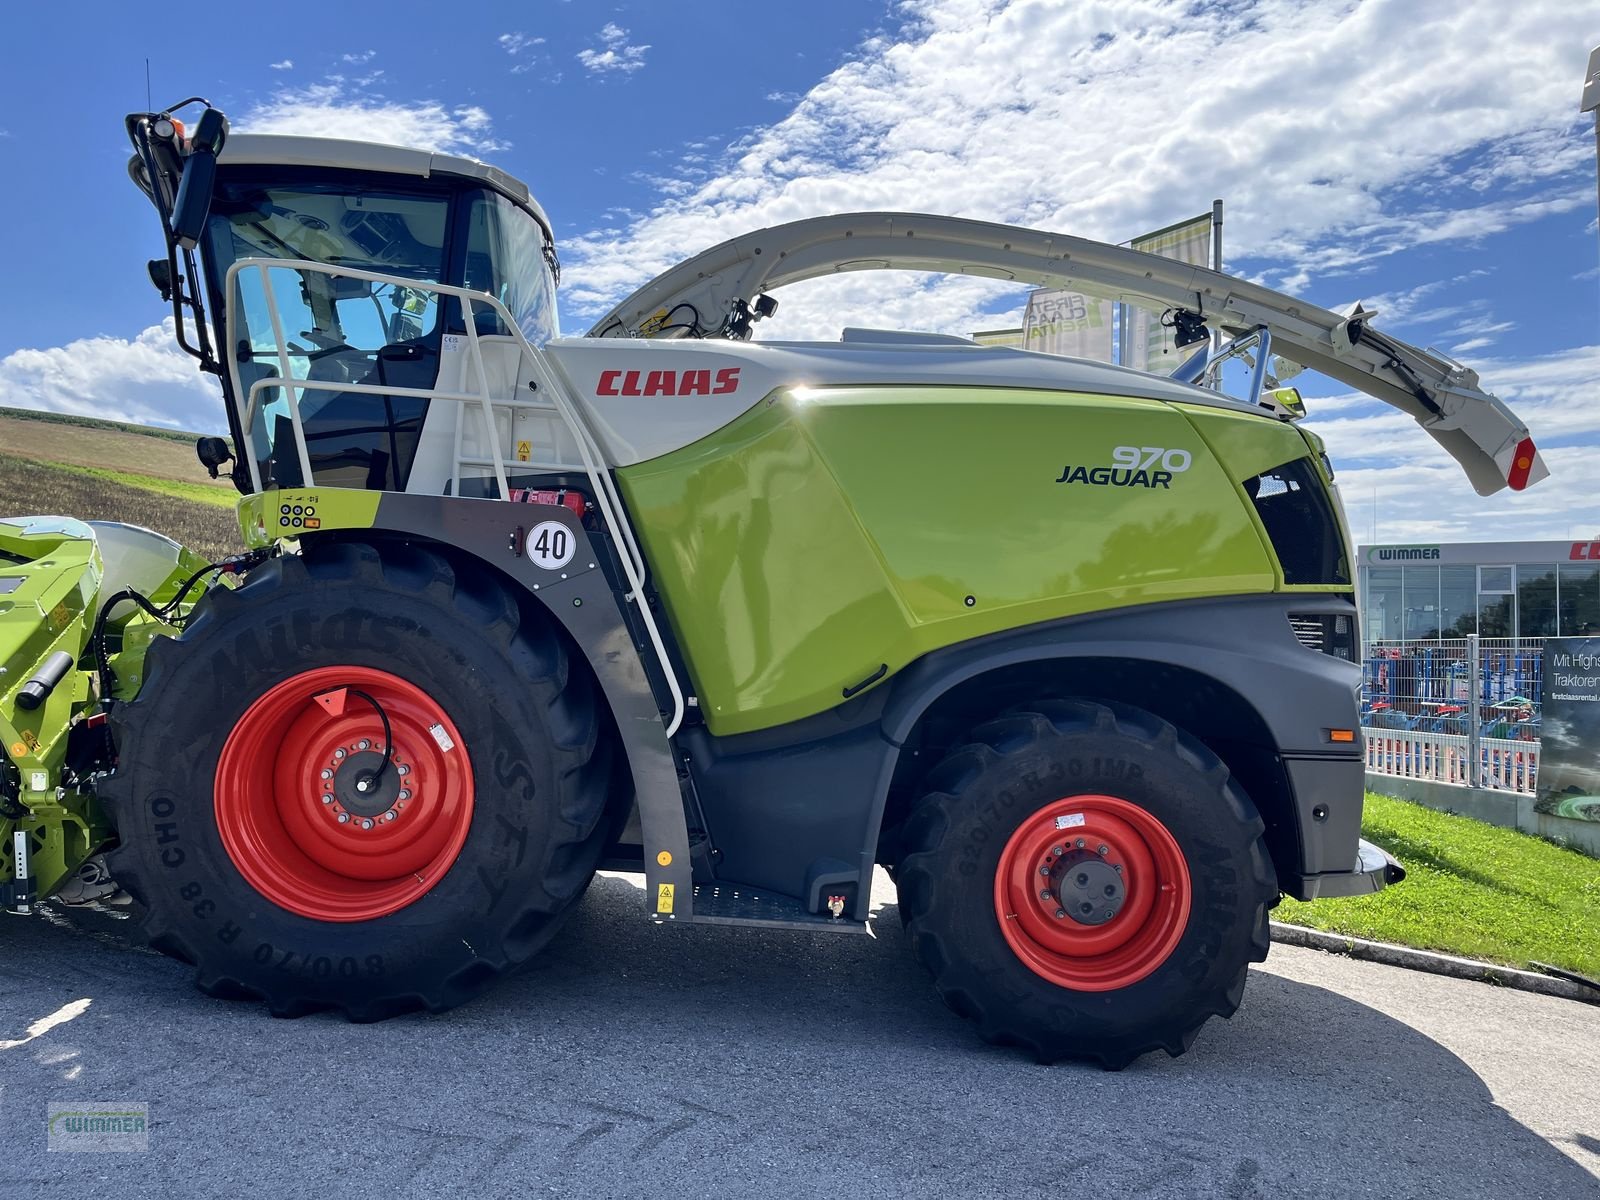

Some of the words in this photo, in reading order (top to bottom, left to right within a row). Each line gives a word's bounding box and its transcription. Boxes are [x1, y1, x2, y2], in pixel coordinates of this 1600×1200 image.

[596, 367, 741, 397] CLAAS
[1112, 446, 1192, 472] 970
[1055, 465, 1172, 489] JAGUAR
[534, 529, 566, 560] 40
[1379, 548, 1440, 561] WIMMER
[1553, 653, 1570, 667] Mit
[1049, 758, 1082, 780] 30
[152, 797, 187, 870] CHO
[178, 880, 217, 920] 38
[216, 923, 242, 946] R
[252, 941, 386, 980] 800/70
